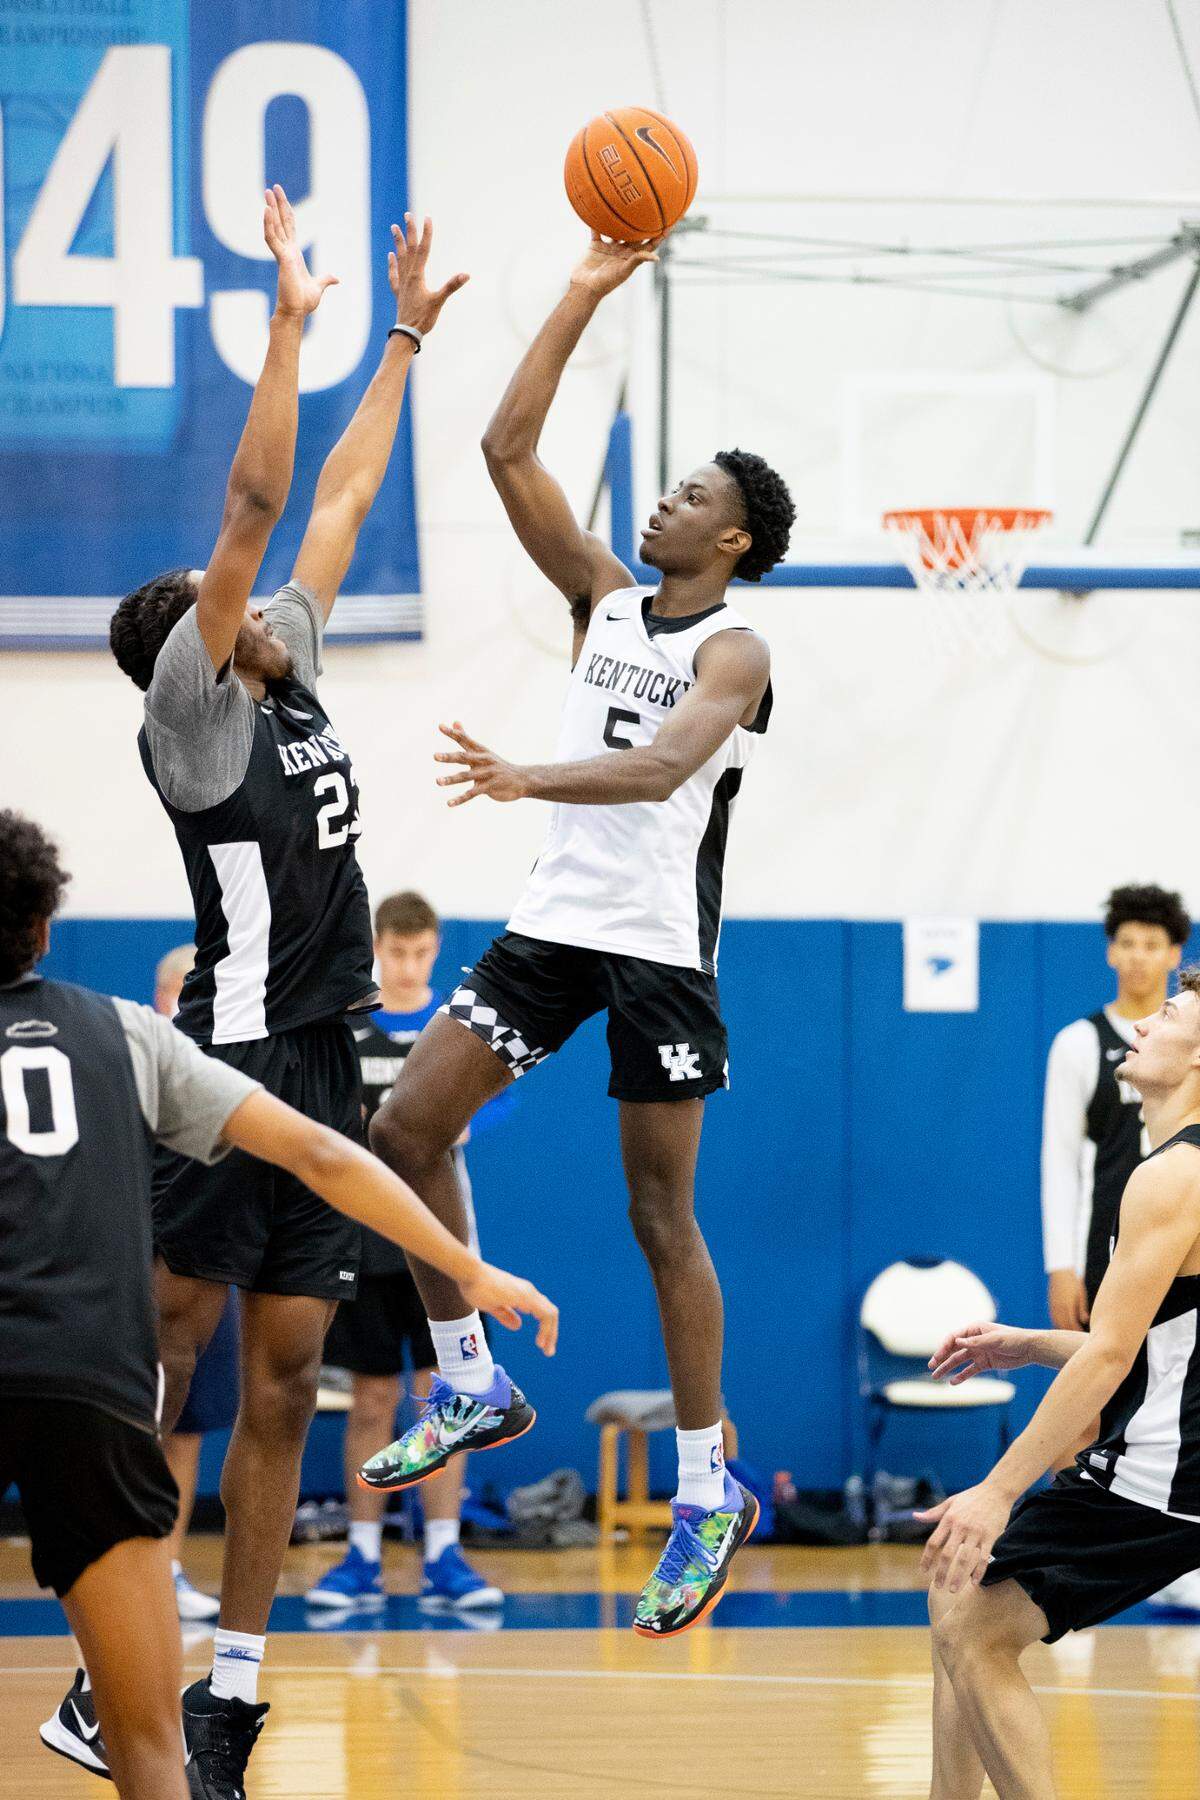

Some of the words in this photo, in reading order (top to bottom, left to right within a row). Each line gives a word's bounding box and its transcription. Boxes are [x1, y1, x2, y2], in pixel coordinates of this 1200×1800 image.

[598, 143, 642, 205] ELITE
[0, 42, 371, 393] 49
[314, 771, 362, 850] 2
[1, 1045, 79, 1157] 0
[658, 1043, 703, 1081] UK
